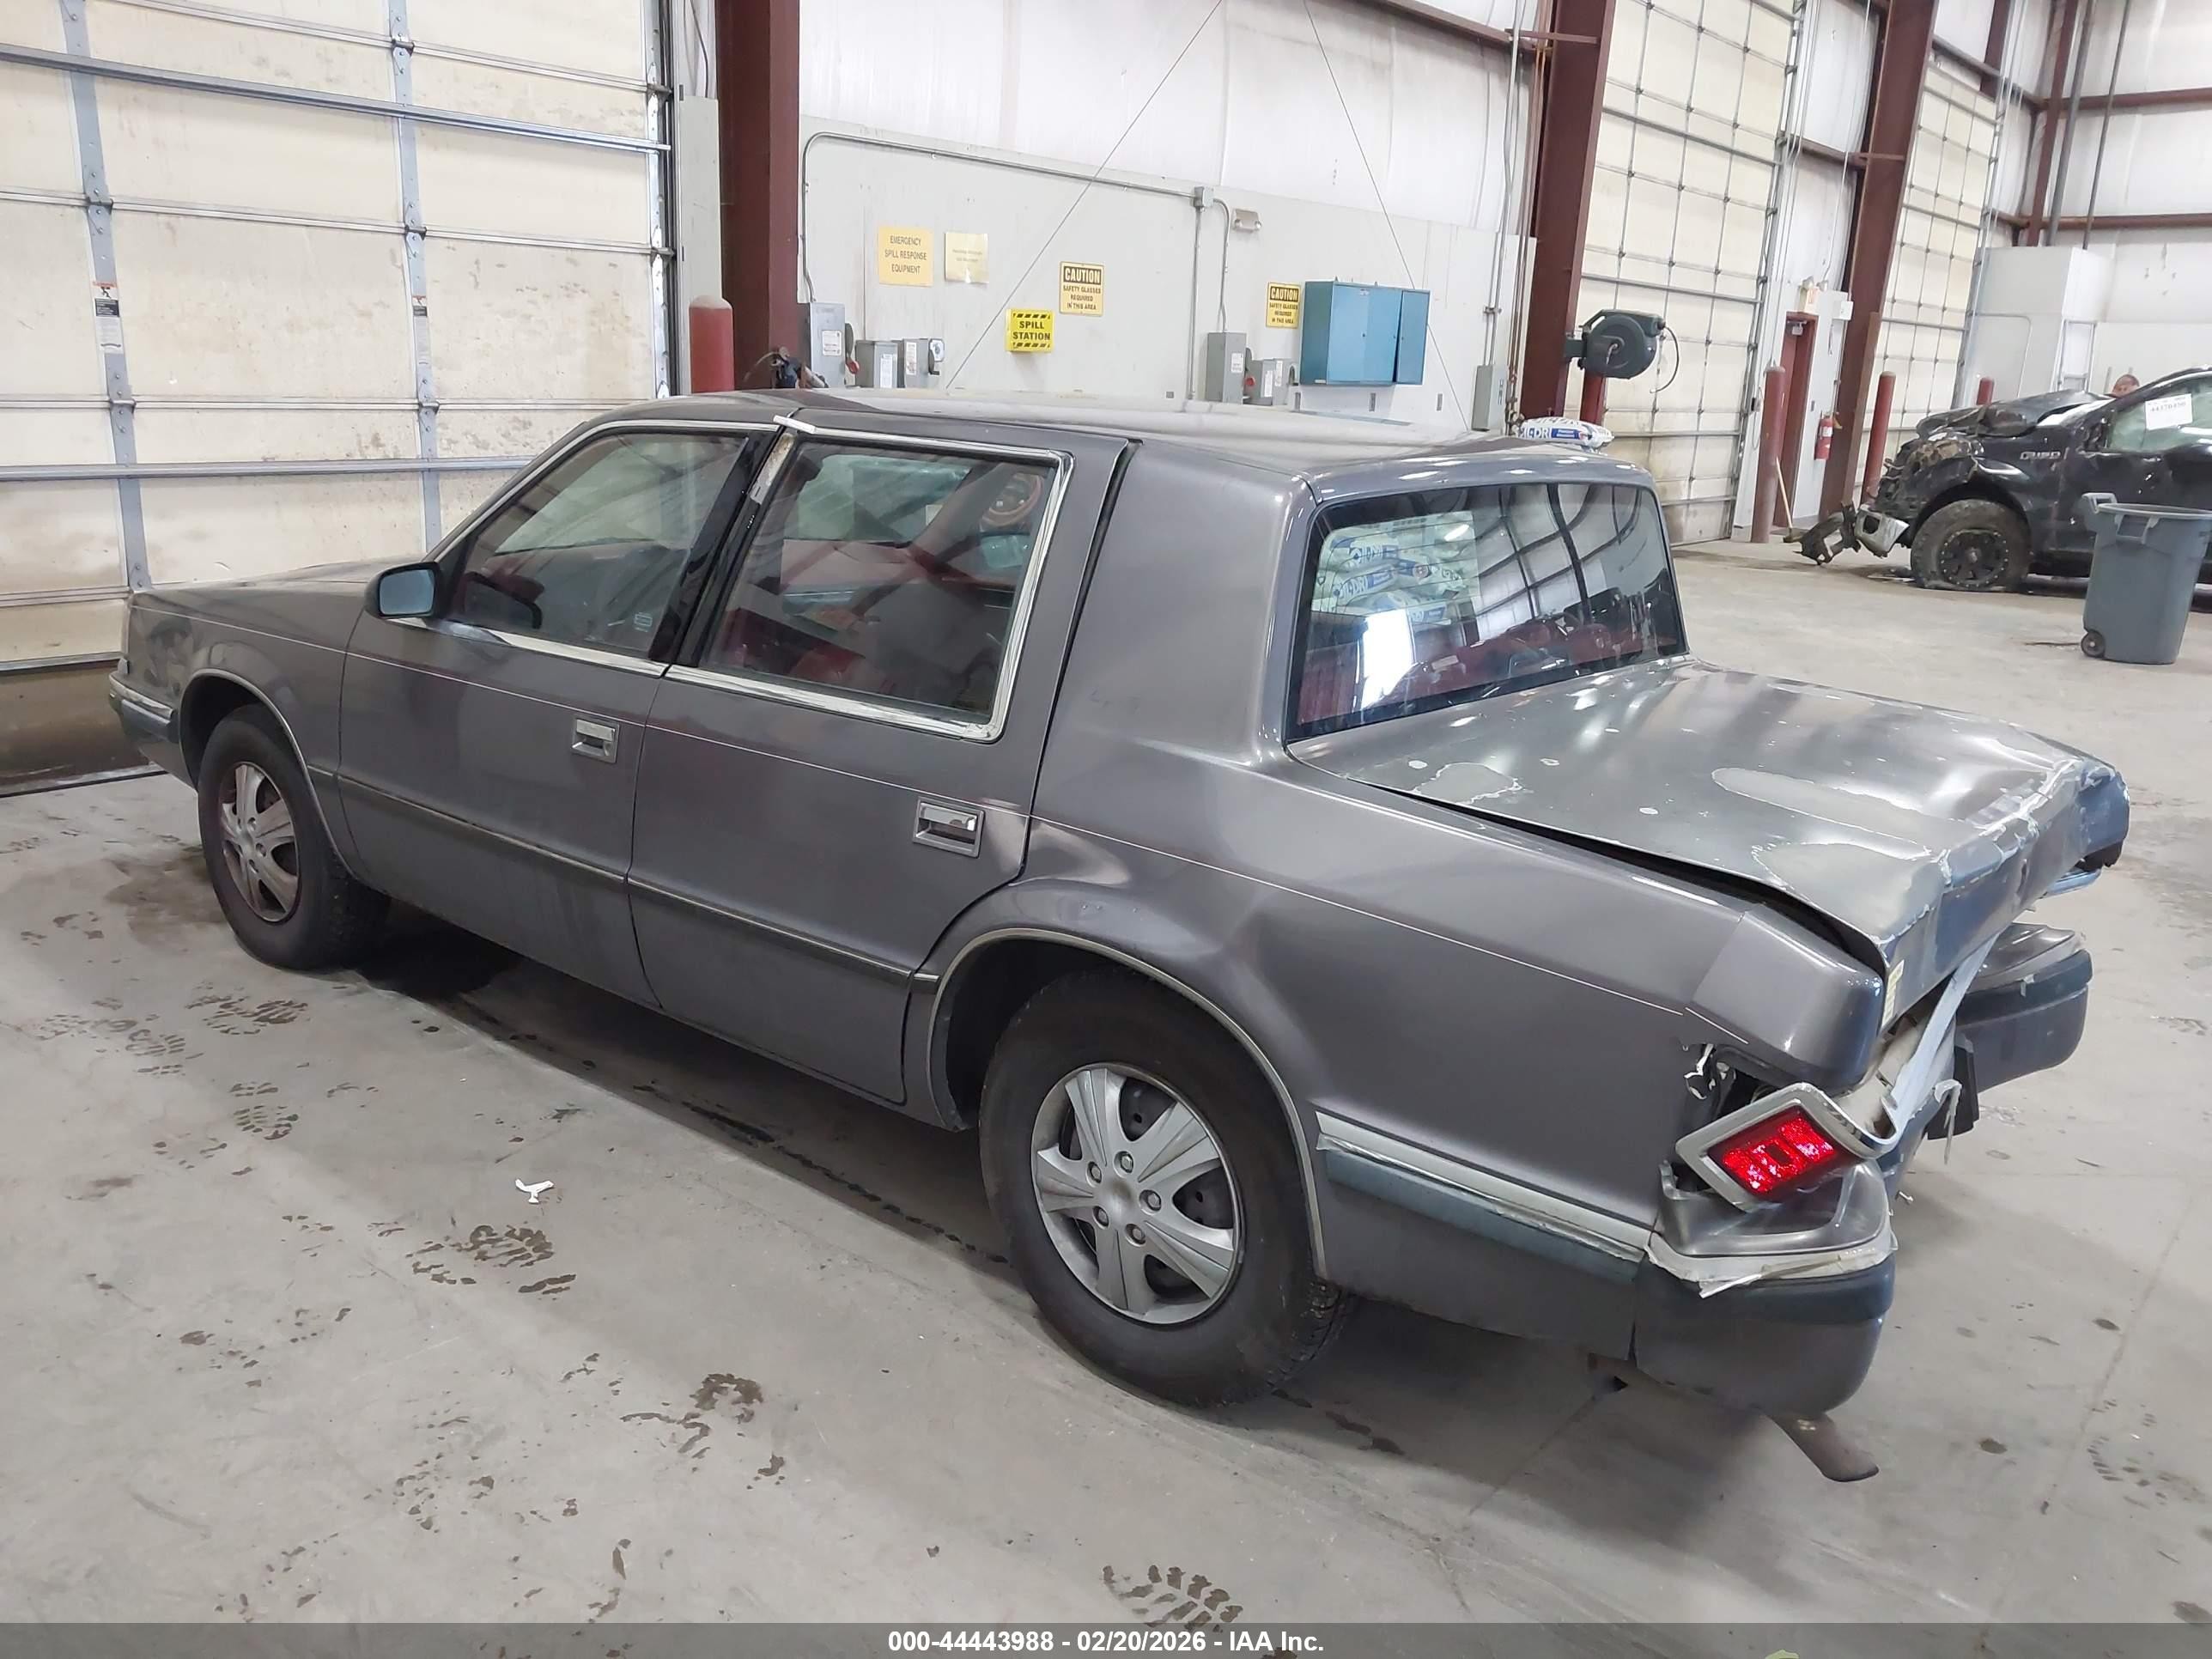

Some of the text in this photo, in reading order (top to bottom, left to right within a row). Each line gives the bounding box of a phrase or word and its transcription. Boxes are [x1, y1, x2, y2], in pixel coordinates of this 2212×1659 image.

[890, 235, 921, 246] EMERGENCY
[884, 249, 927, 261] SPILL RESPONSE
[891, 264, 921, 274] EQUIPMENT
[1065, 267, 1100, 284] CAUTION
[1271, 288, 1297, 301] CAUTION
[1019, 321, 1044, 330] SPILL
[1013, 331, 1050, 341] STATION
